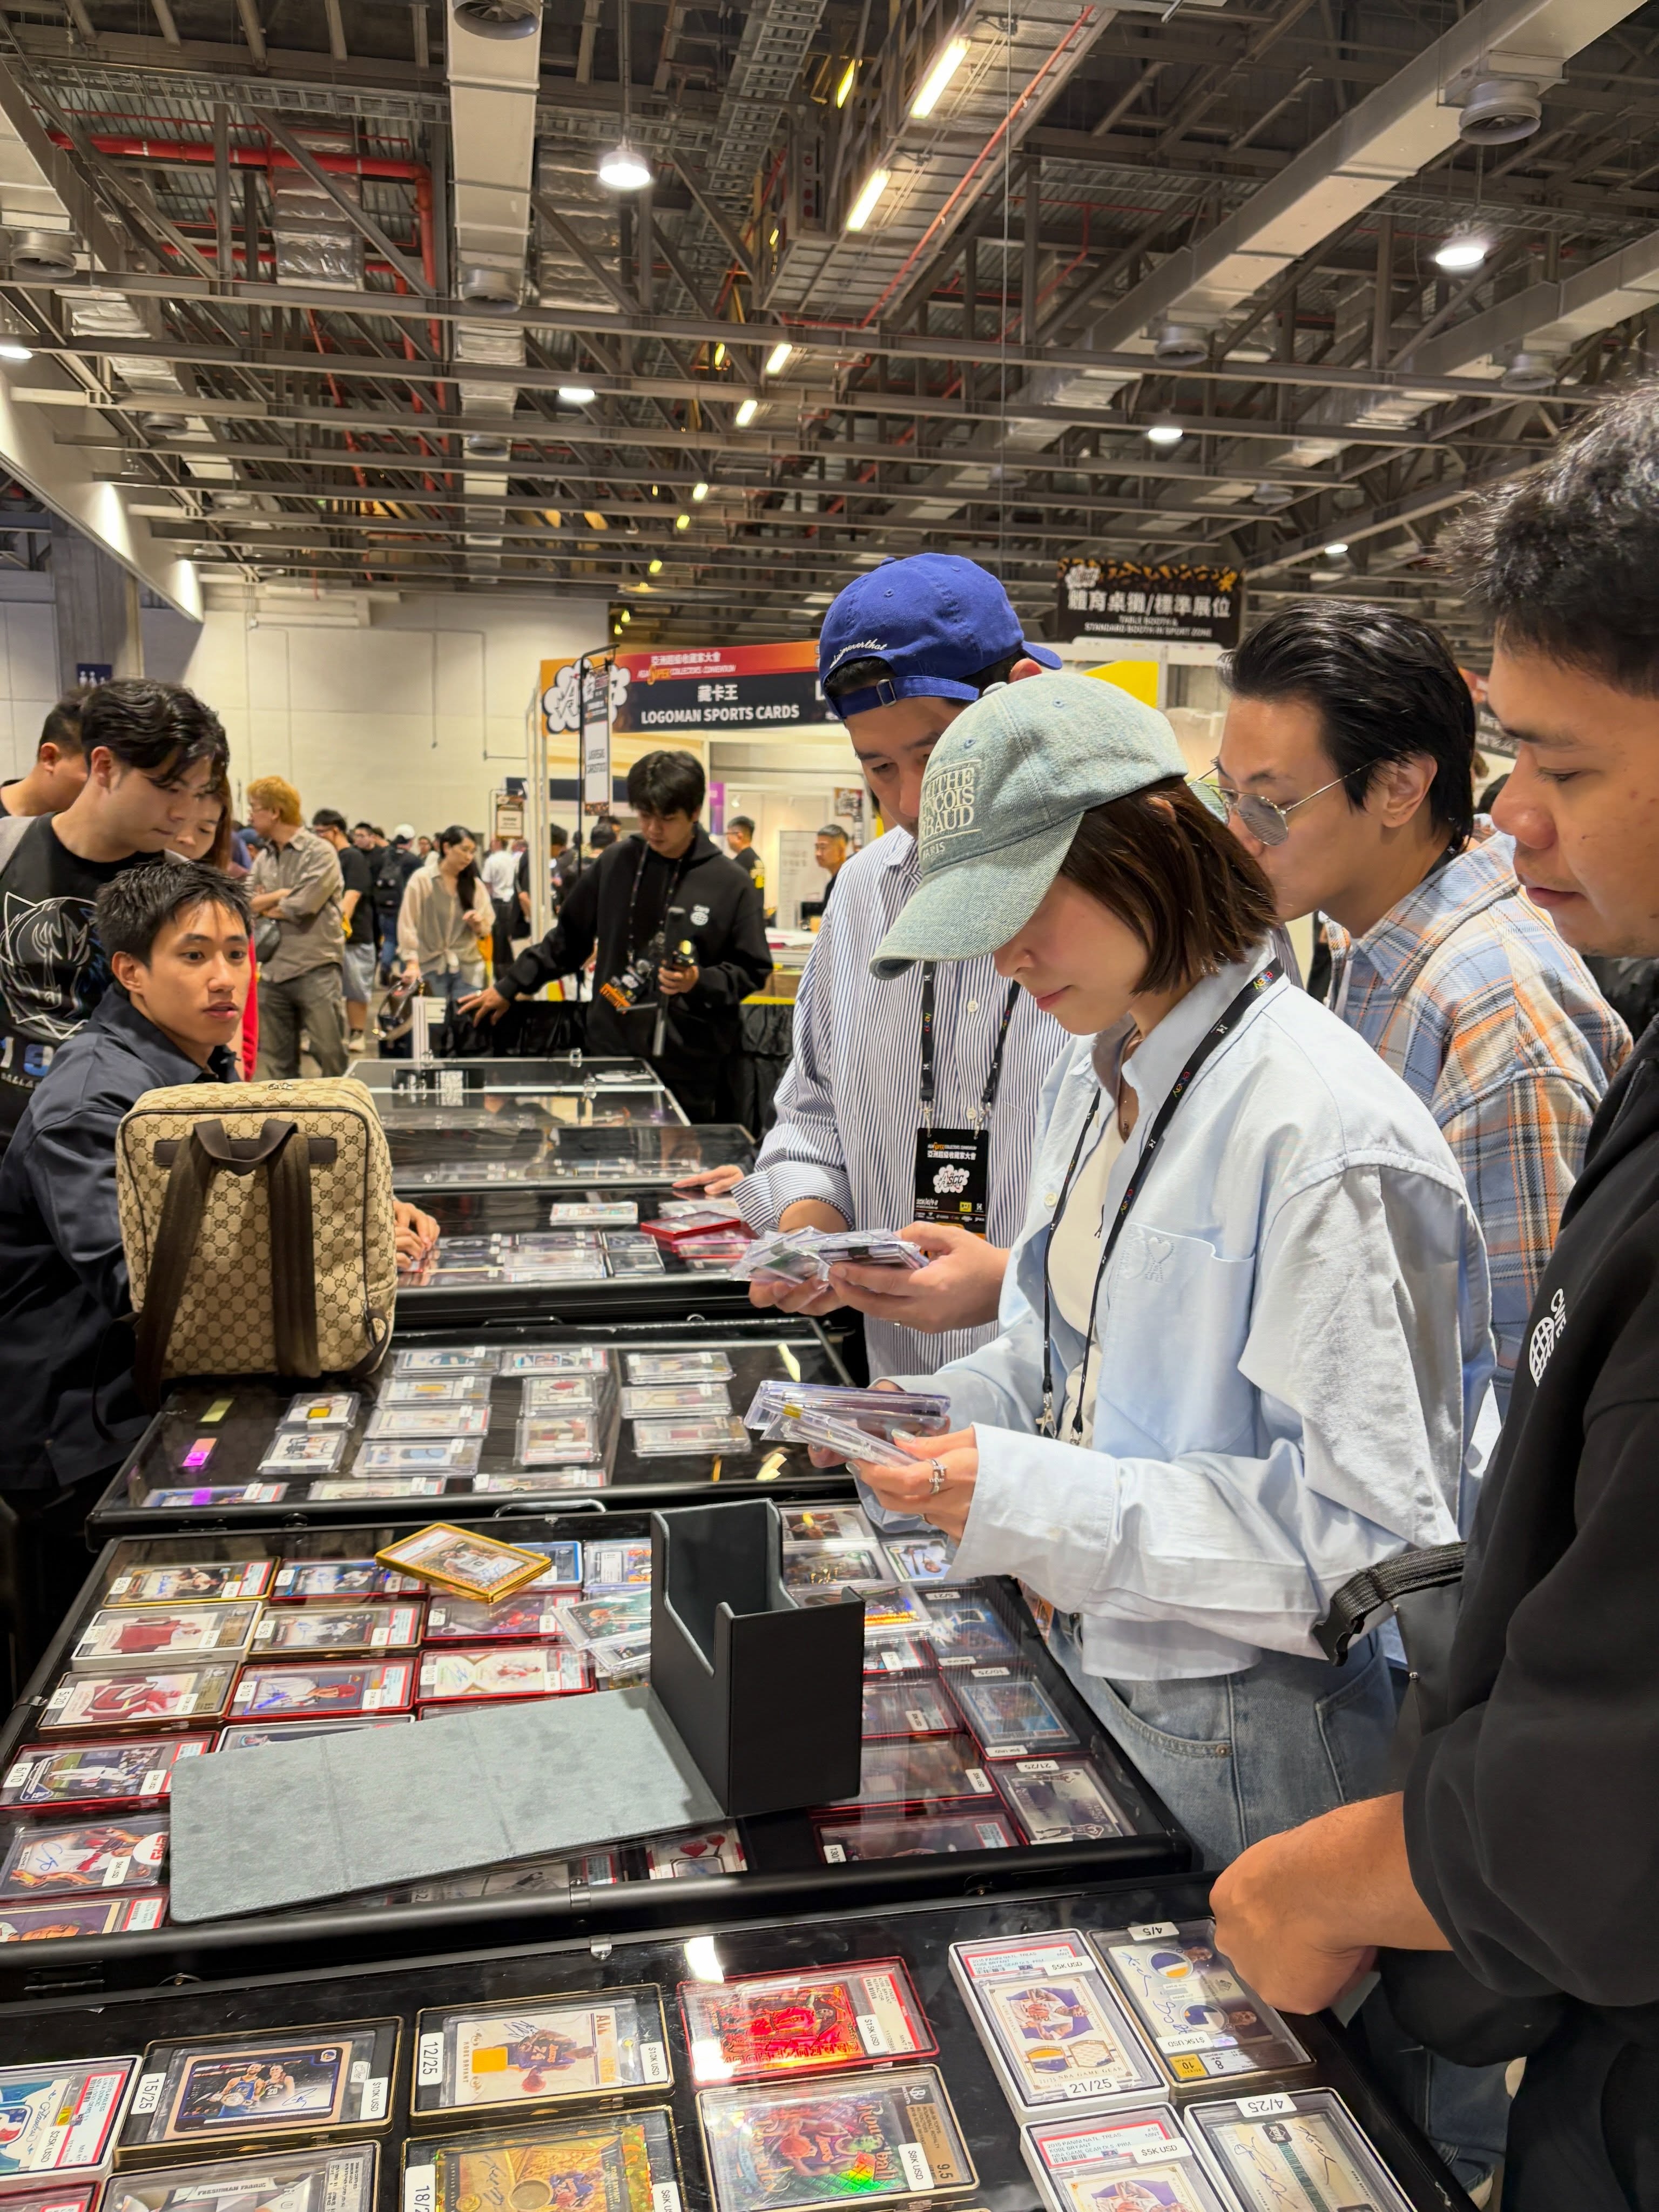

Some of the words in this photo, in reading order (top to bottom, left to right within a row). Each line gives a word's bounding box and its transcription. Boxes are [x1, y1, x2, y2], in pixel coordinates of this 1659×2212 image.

[640, 709, 702, 724] LOGOMAN
[703, 706, 754, 721] SPORTS
[756, 704, 800, 719] CARDS
[53, 1690, 70, 1706] 5/20
[239, 1683, 253, 1698] 8/10
[1142, 1926, 1163, 1937] 4/5
[873, 1978, 885, 2001] REFRACTOR
[596, 2014, 607, 2036] ALL
[864, 2019, 876, 2034] $15K
[870, 2034, 880, 2046] USD
[1167, 2039, 1184, 2047] USD
[1185, 2036, 1205, 2045] $15K
[422, 2041, 438, 2075] 12/25
[531, 2046, 546, 2061] 24
[648, 2046, 658, 2063] $10K
[651, 2063, 660, 2076] USD
[1182, 2061, 1194, 2069] 10
[1215, 2060, 1224, 2069] 8
[139, 2078, 159, 2109] 15/25
[372, 2081, 382, 2098] $10K
[1069, 2079, 1112, 2094] 21/25
[370, 2099, 379, 2112] USD
[1247, 2099, 1283, 2113] 4/25
[47, 2130, 60, 2147] $25K
[929, 2130, 940, 2149] ROYALTY
[41, 2146, 52, 2163] USD
[908, 2150, 919, 2164] $8K
[1141, 2148, 1160, 2157] $5K
[1160, 2144, 1178, 2153] USD
[913, 2164, 923, 2180] USD
[937, 2163, 954, 2179] 9.5
[660, 2190, 673, 2205] $8K
